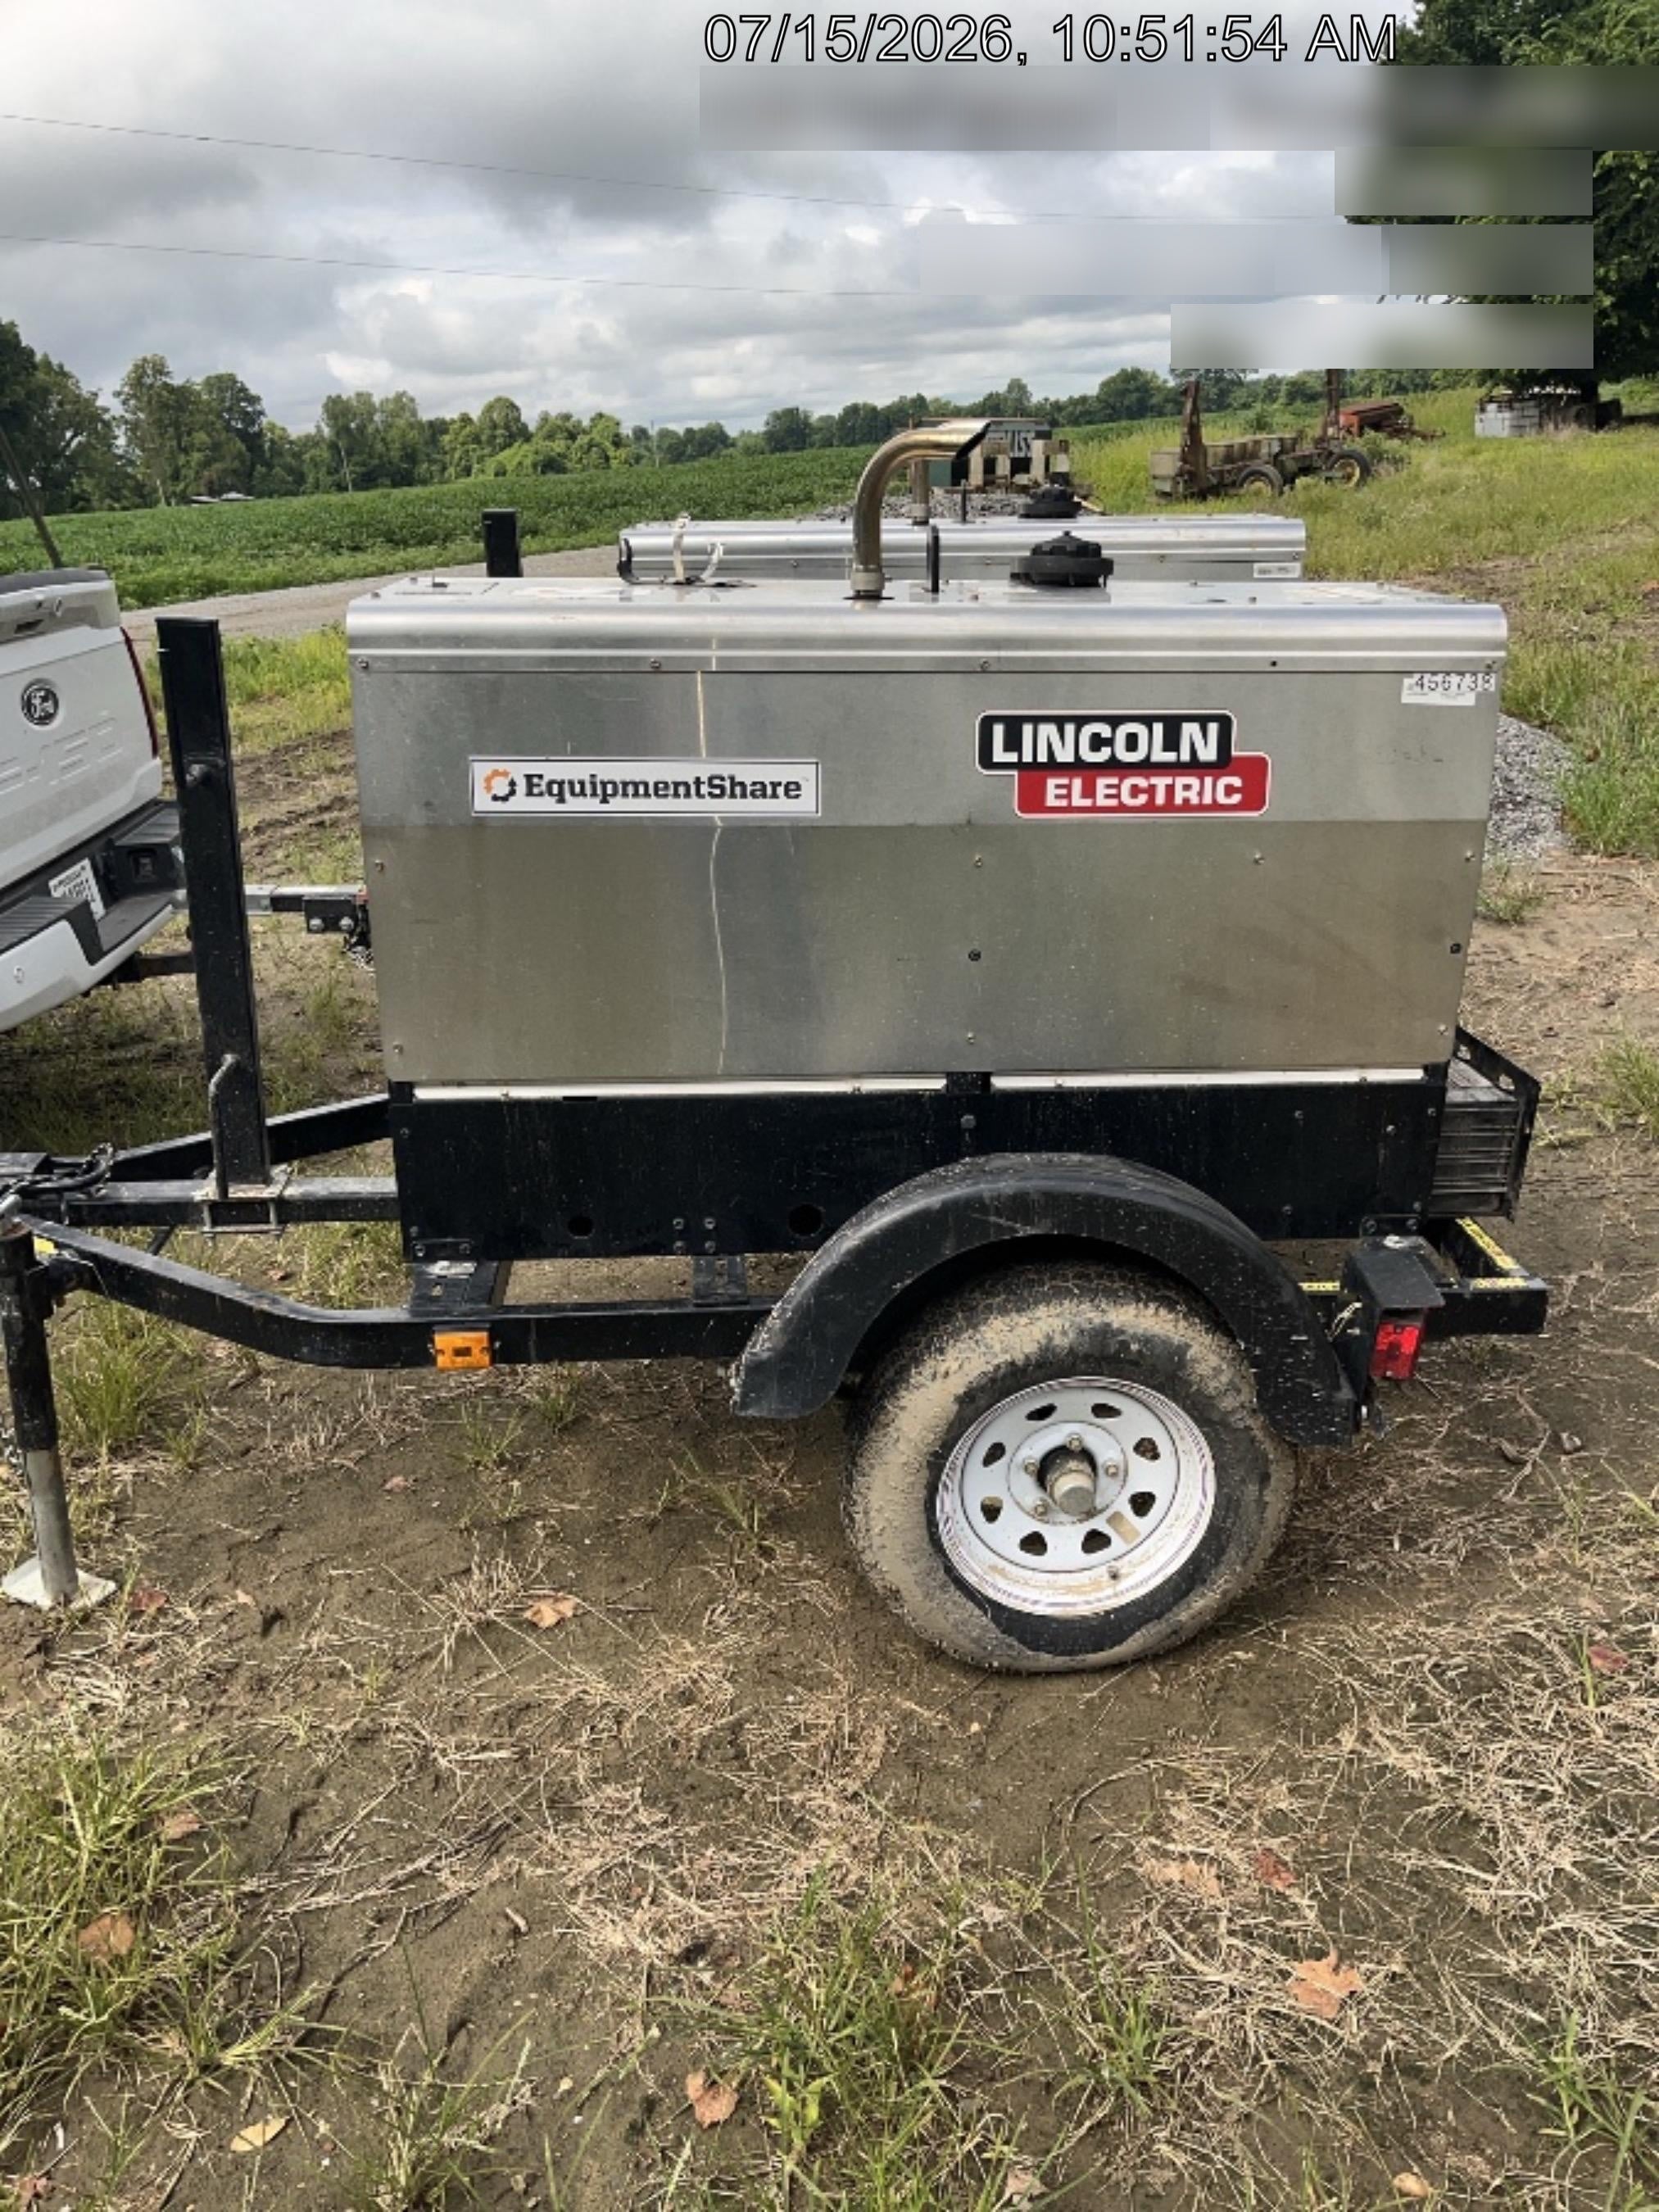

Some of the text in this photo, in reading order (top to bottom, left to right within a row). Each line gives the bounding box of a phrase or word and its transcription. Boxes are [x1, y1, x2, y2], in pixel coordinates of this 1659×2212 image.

[991, 722, 1220, 763] LINCOLN
[524, 773, 802, 805] EquipmentShare
[1045, 776, 1243, 807] ELECTRIC
